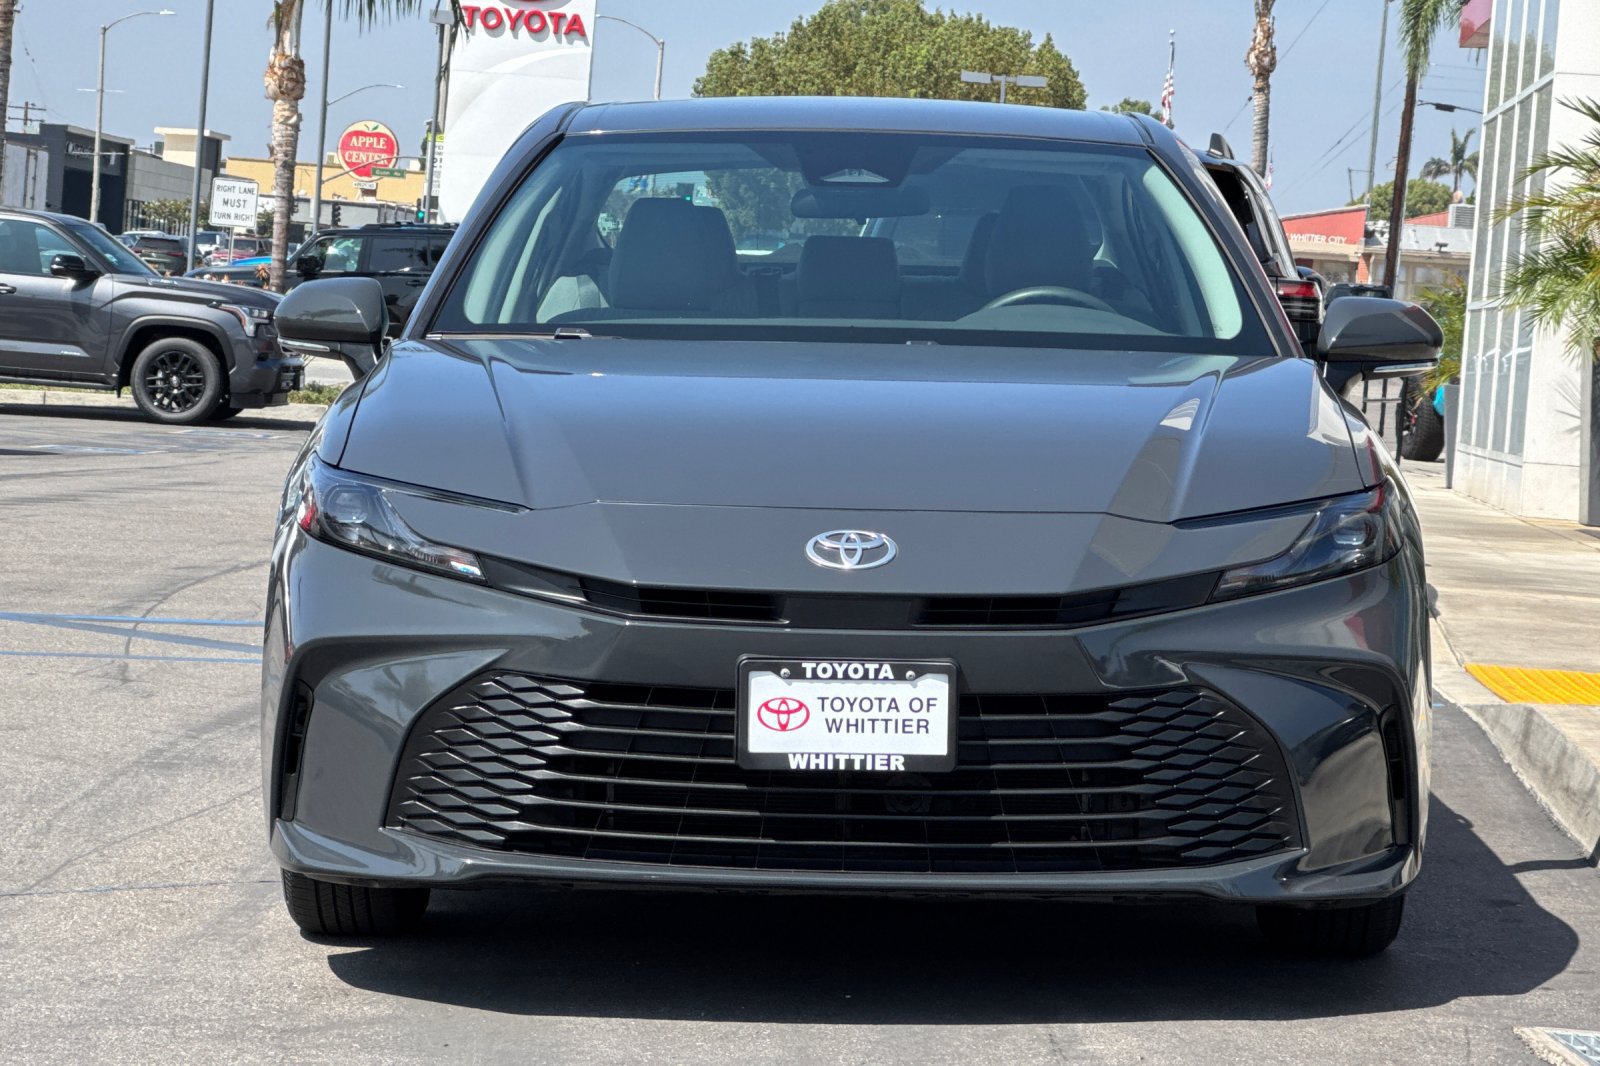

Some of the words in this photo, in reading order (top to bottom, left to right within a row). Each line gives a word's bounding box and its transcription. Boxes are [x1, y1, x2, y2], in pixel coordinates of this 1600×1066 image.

[461, 5, 586, 37] TOYOTA
[350, 135, 387, 149] APPLE
[344, 150, 389, 165] CENTER
[216, 185, 236, 193] RIGHT
[239, 187, 255, 195] LANE
[222, 198, 247, 208] MUST
[214, 211, 231, 220] TURN
[234, 213, 253, 222] RIGHT
[1290, 233, 1326, 244] WHITTIER
[1327, 235, 1347, 244] CITY
[802, 662, 895, 680] TOYOTA
[817, 696, 900, 713] TOYOTA
[908, 697, 938, 713] OF
[825, 717, 930, 734] WHITTIER
[788, 753, 905, 771] WHITTIER
